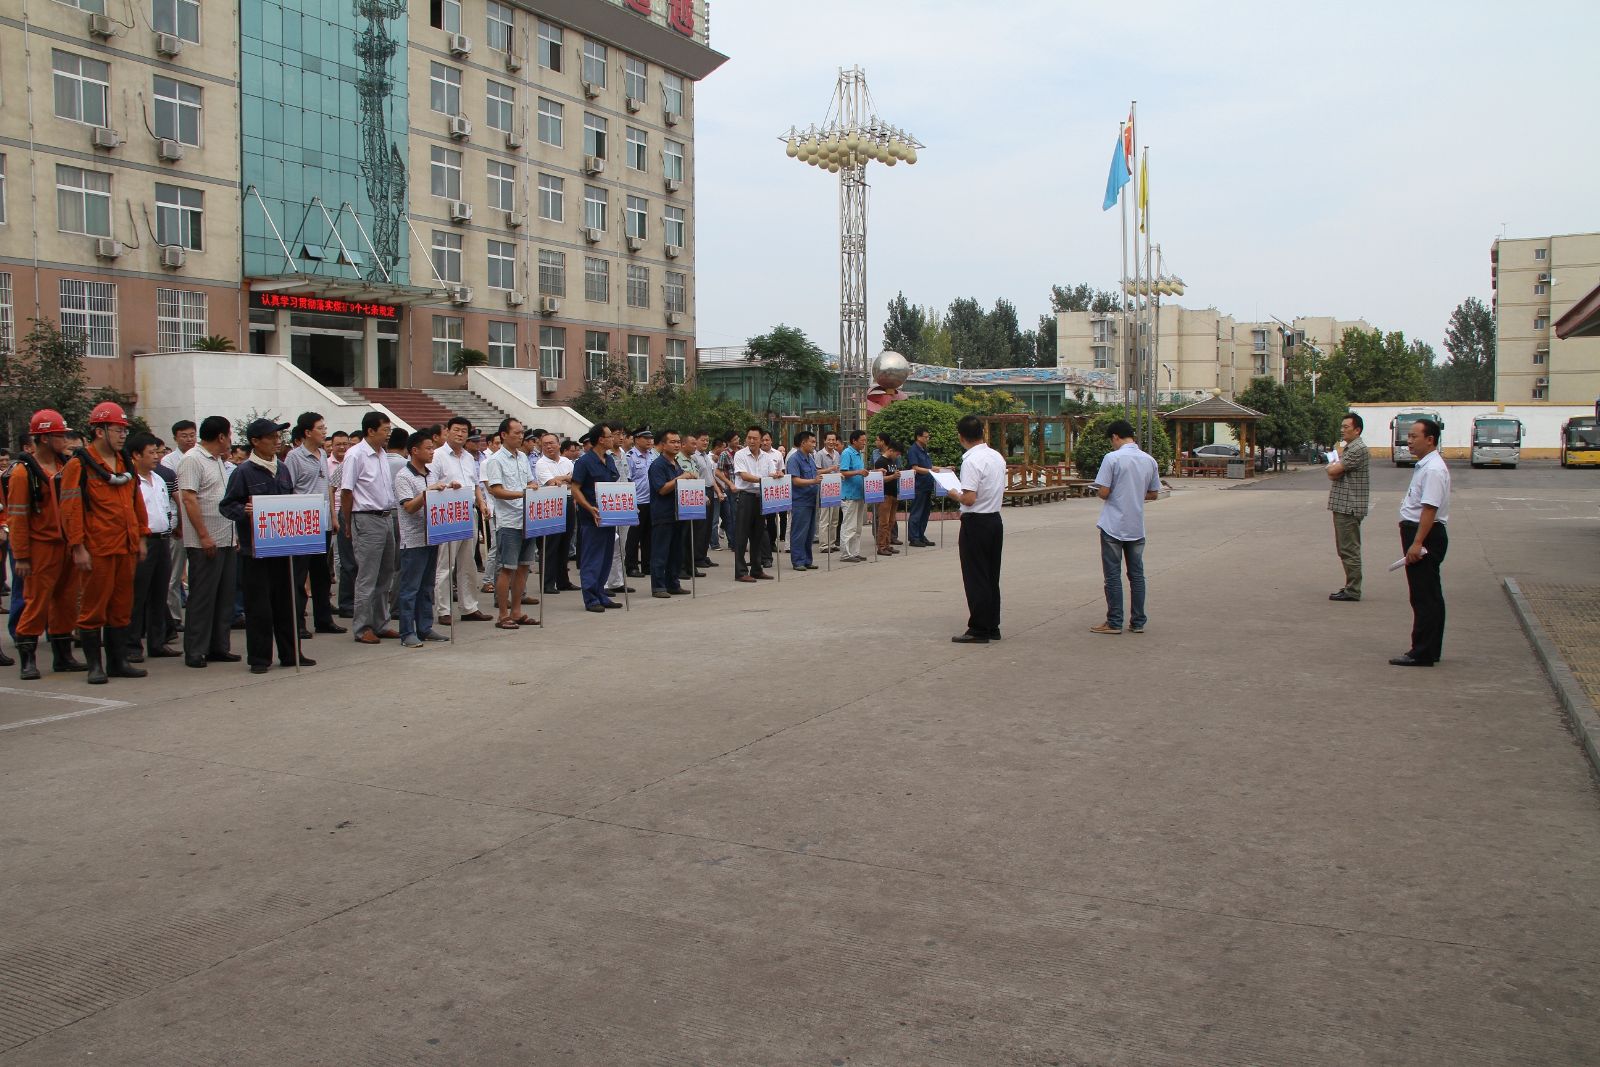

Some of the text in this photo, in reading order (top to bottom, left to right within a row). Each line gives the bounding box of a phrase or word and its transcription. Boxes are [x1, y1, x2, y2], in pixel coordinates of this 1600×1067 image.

[430, 500, 470, 526] 技术保障组
[528, 497, 563, 520] 机电控制组
[258, 509, 320, 538] 井下现场处理组
